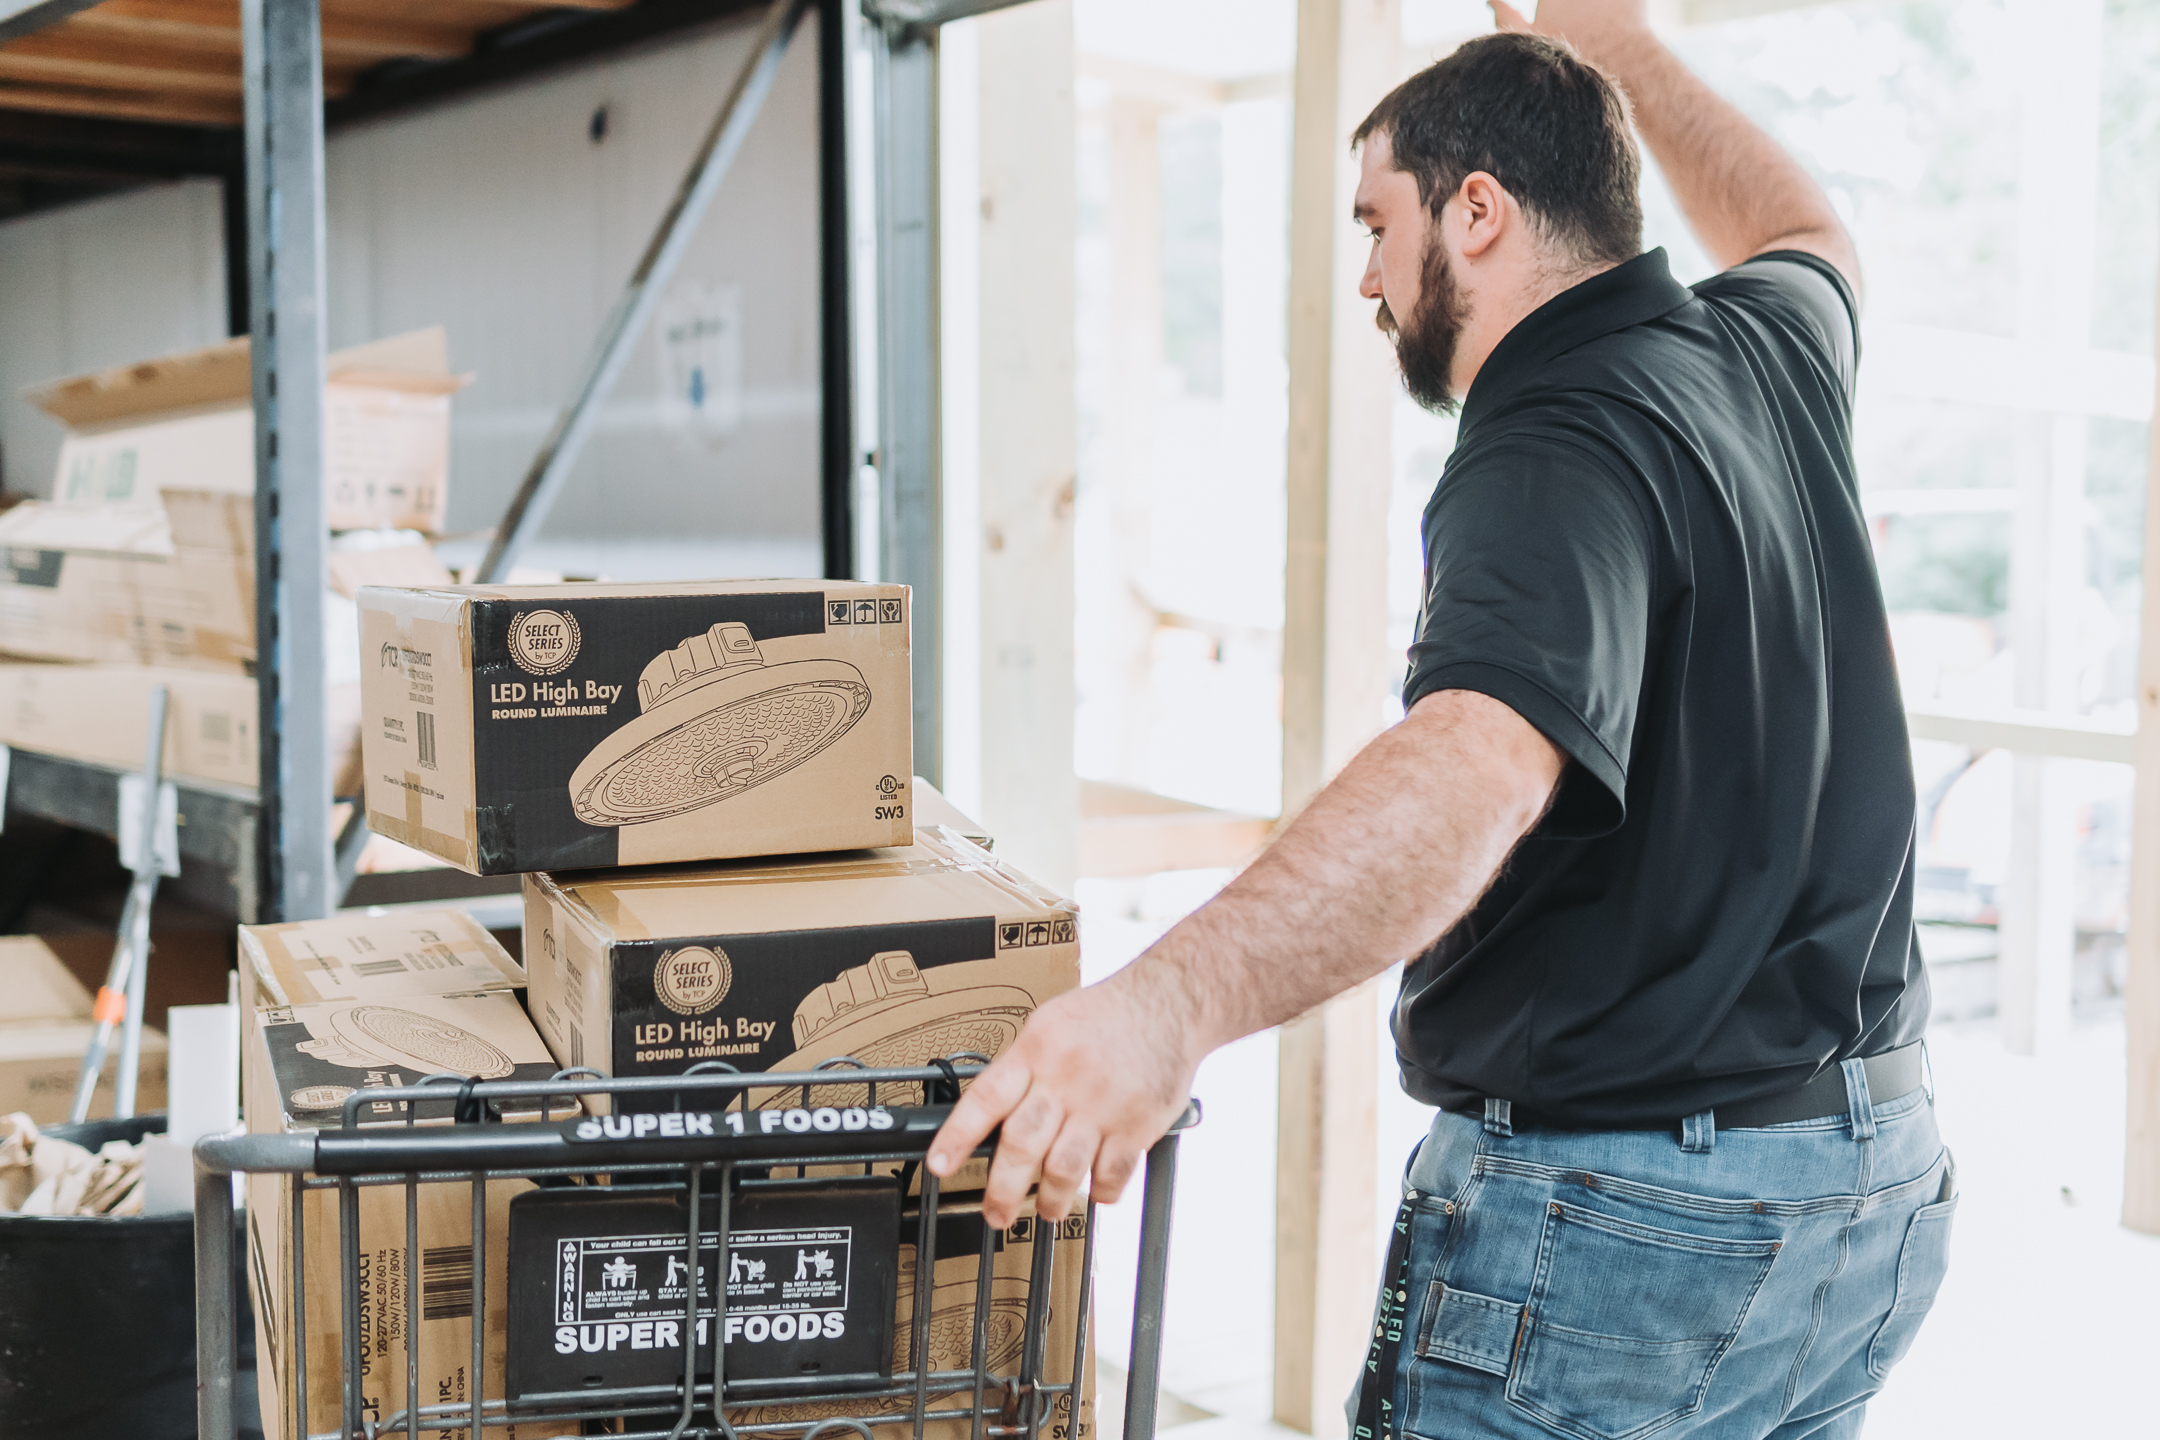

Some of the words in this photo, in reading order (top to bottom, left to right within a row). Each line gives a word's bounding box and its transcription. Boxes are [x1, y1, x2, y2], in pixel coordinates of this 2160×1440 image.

[525, 624, 561, 637] SELECT
[528, 638, 563, 650] SERIES
[535, 652, 543, 661] by
[491, 683, 526, 703] LED
[532, 679, 579, 706] High
[586, 680, 622, 704] Bay
[492, 708, 537, 719] ROUND
[541, 705, 608, 717] LUMINAIRE
[875, 805, 904, 820] SW3
[672, 961, 711, 976] SELECT
[676, 975, 713, 989] SERIES
[683, 991, 691, 1000] by
[693, 990, 705, 998] TCP
[636, 1023, 673, 1045] LED
[680, 1017, 729, 1046] High
[736, 1017, 776, 1042] Bay
[636, 1048, 684, 1062] ROUND
[688, 1043, 760, 1058] LUMINAIRE
[576, 1112, 714, 1139] SUPER
[725, 1111, 745, 1135] 1
[760, 1105, 894, 1134] FOODS
[1395, 1204, 1412, 1234] A-1
[376, 1249, 386, 1264] Hz
[377, 1265, 388, 1296] 50/60
[563, 1252, 577, 1322] WARNING
[390, 1248, 401, 1341] 150W/120W/80W
[377, 1297, 388, 1358] 120-277VAC
[554, 1321, 680, 1354] SUPER
[696, 1318, 708, 1346] 1
[724, 1311, 845, 1344] FOODS
[1367, 1342, 1381, 1373] A-1
[1380, 1287, 1393, 1324] LED
[1382, 1398, 1392, 1429] A-1
